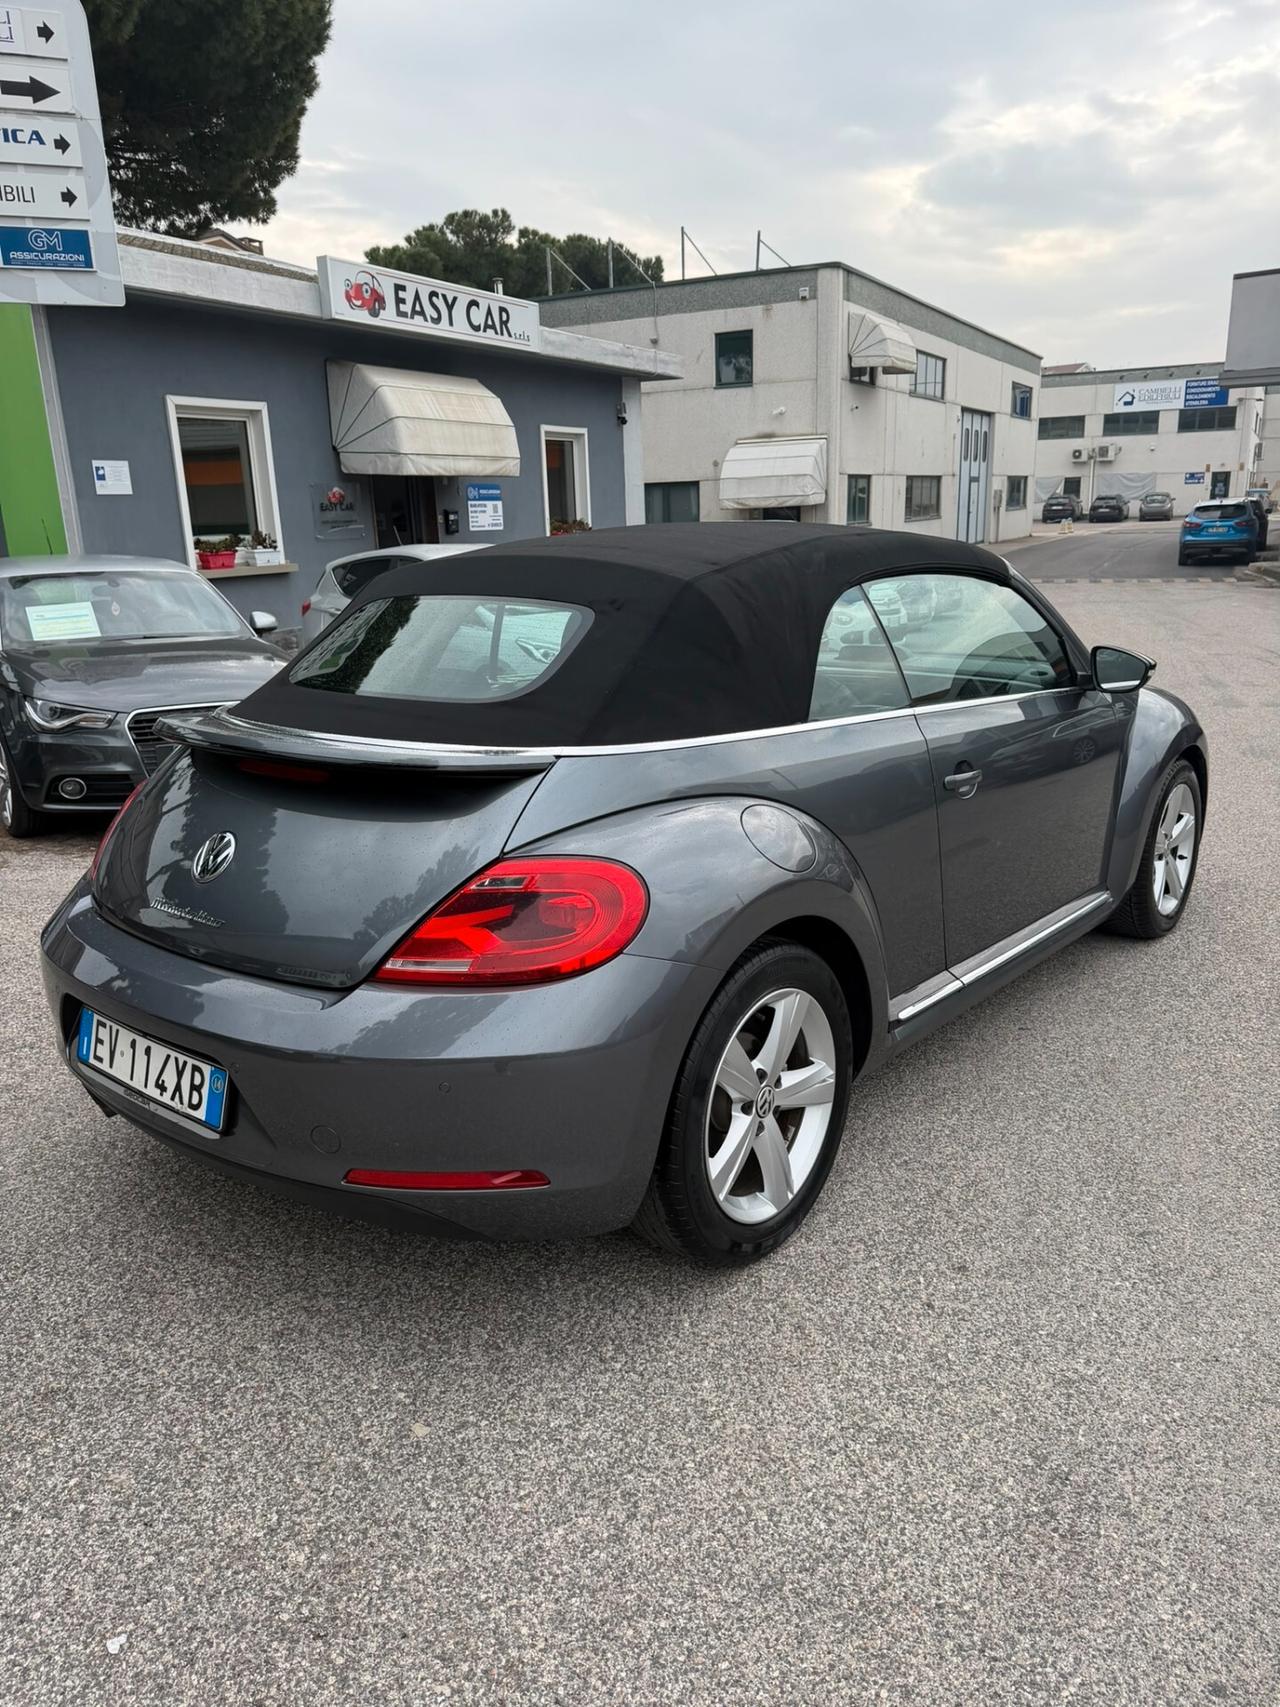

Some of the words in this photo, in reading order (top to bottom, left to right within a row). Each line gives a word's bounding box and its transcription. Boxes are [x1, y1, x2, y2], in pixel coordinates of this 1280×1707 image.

[0, 127, 47, 146] ICA
[28, 229, 63, 251] GM
[10, 251, 85, 261] ASSICURAZIONI
[393, 282, 459, 327] EASY
[465, 298, 513, 338] CAR
[320, 502, 338, 511] EASY
[93, 1018, 119, 1069] EV
[130, 1038, 205, 1112] 114XB
